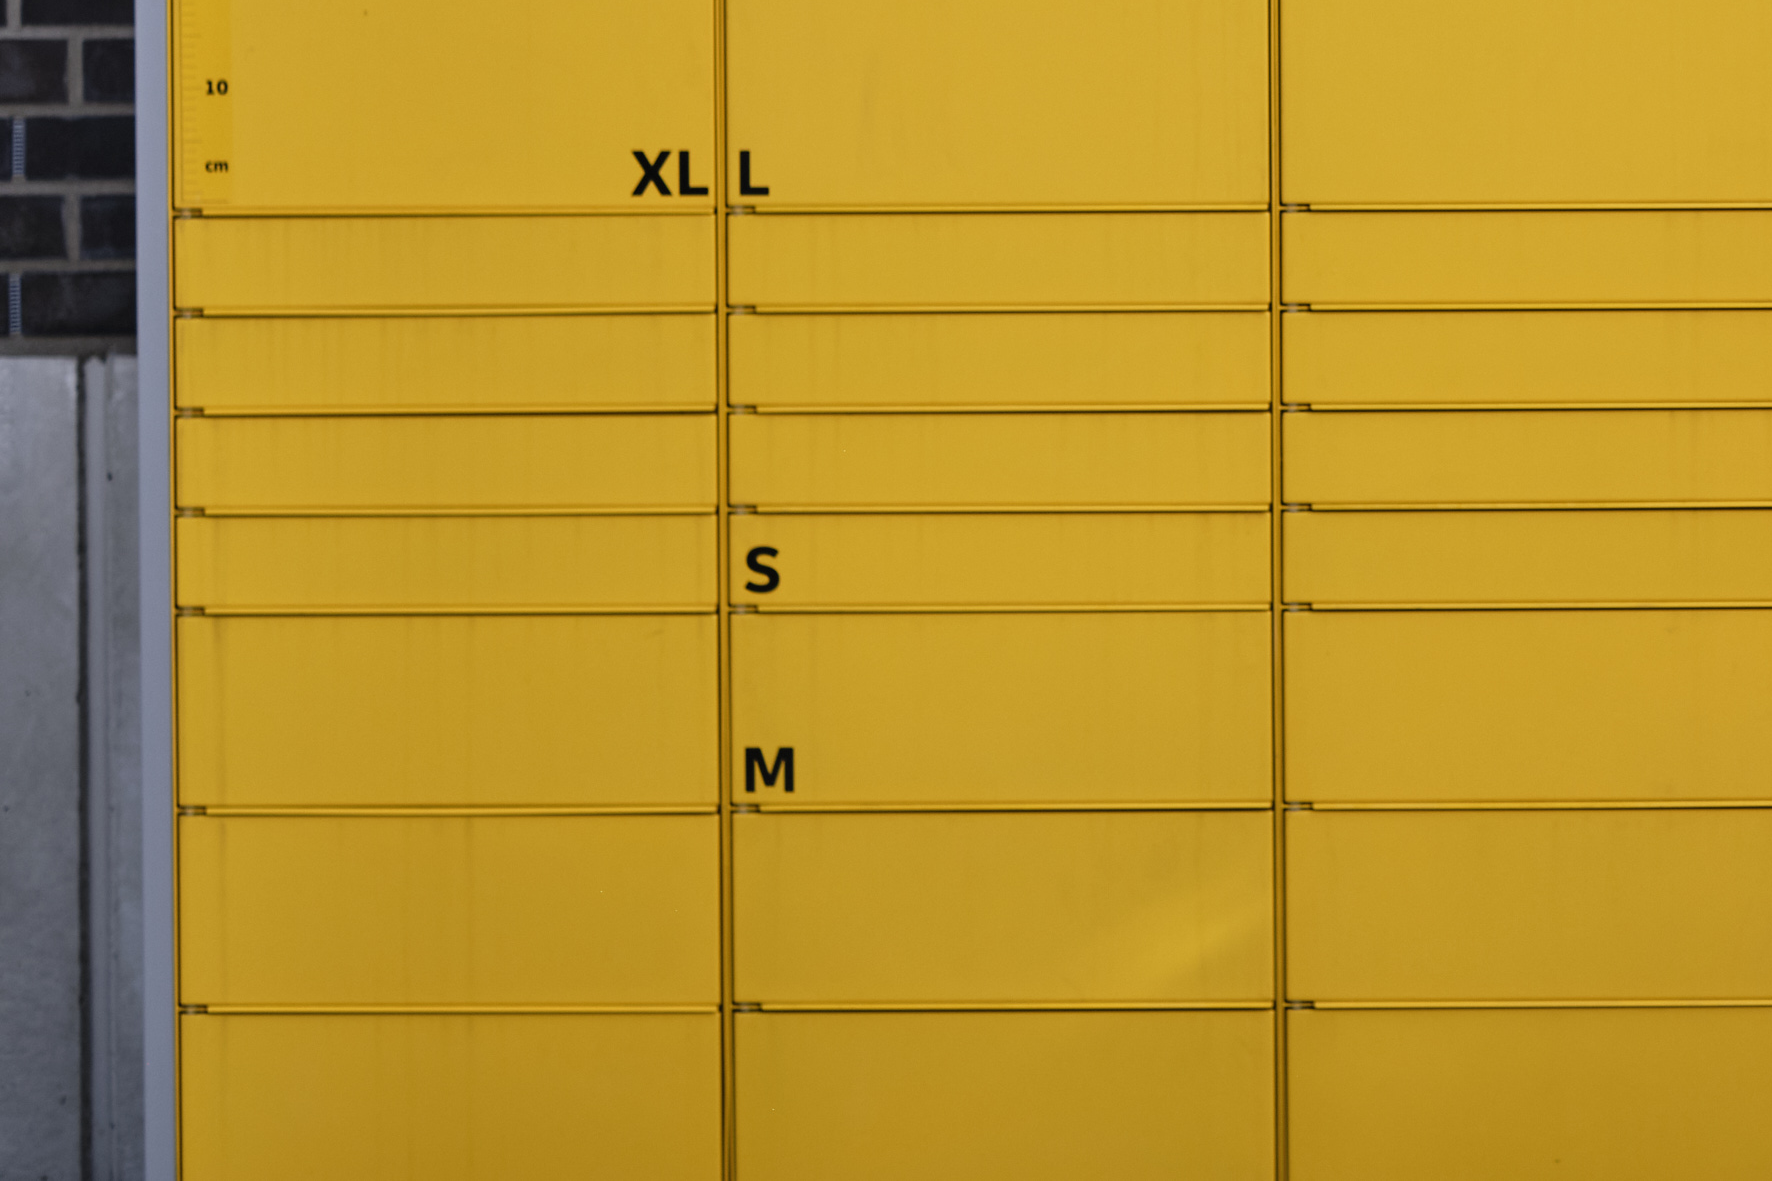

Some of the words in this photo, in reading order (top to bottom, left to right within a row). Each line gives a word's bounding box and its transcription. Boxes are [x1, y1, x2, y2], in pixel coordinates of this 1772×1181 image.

[205, 79, 228, 95] 10
[205, 161, 228, 173] cm
[631, 150, 709, 197] XL
[739, 150, 770, 197] L
[745, 546, 780, 593] S
[745, 747, 795, 793] M
